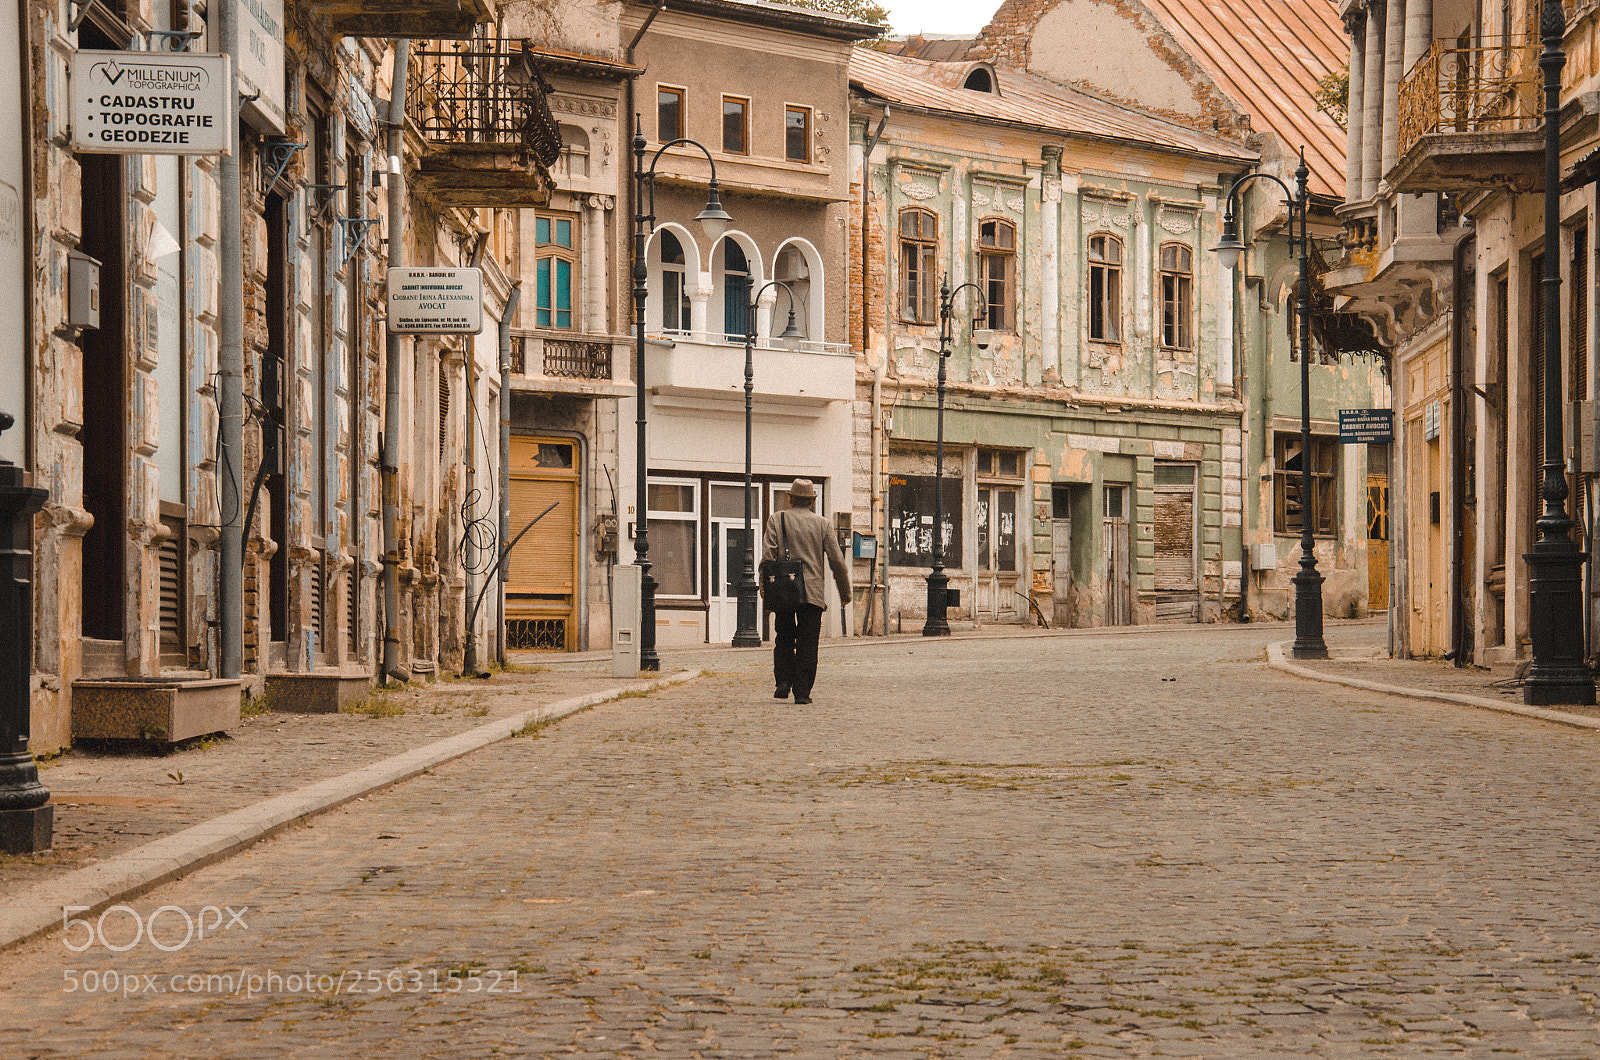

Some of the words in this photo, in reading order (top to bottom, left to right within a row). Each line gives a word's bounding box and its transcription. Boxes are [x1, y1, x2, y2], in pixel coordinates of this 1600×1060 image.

[127, 69, 201, 83] MILLENIUM
[127, 80, 201, 92] TOPOGRAPHICA
[100, 95, 195, 110] CADASTRU
[100, 112, 213, 128] TOPOGRAFIE
[100, 129, 190, 144] GEODEZIE
[419, 293, 437, 301] IRINA
[437, 293, 474, 301] ALEXANDRA
[418, 302, 447, 310] AVOCAT
[627, 505, 635, 515] 10
